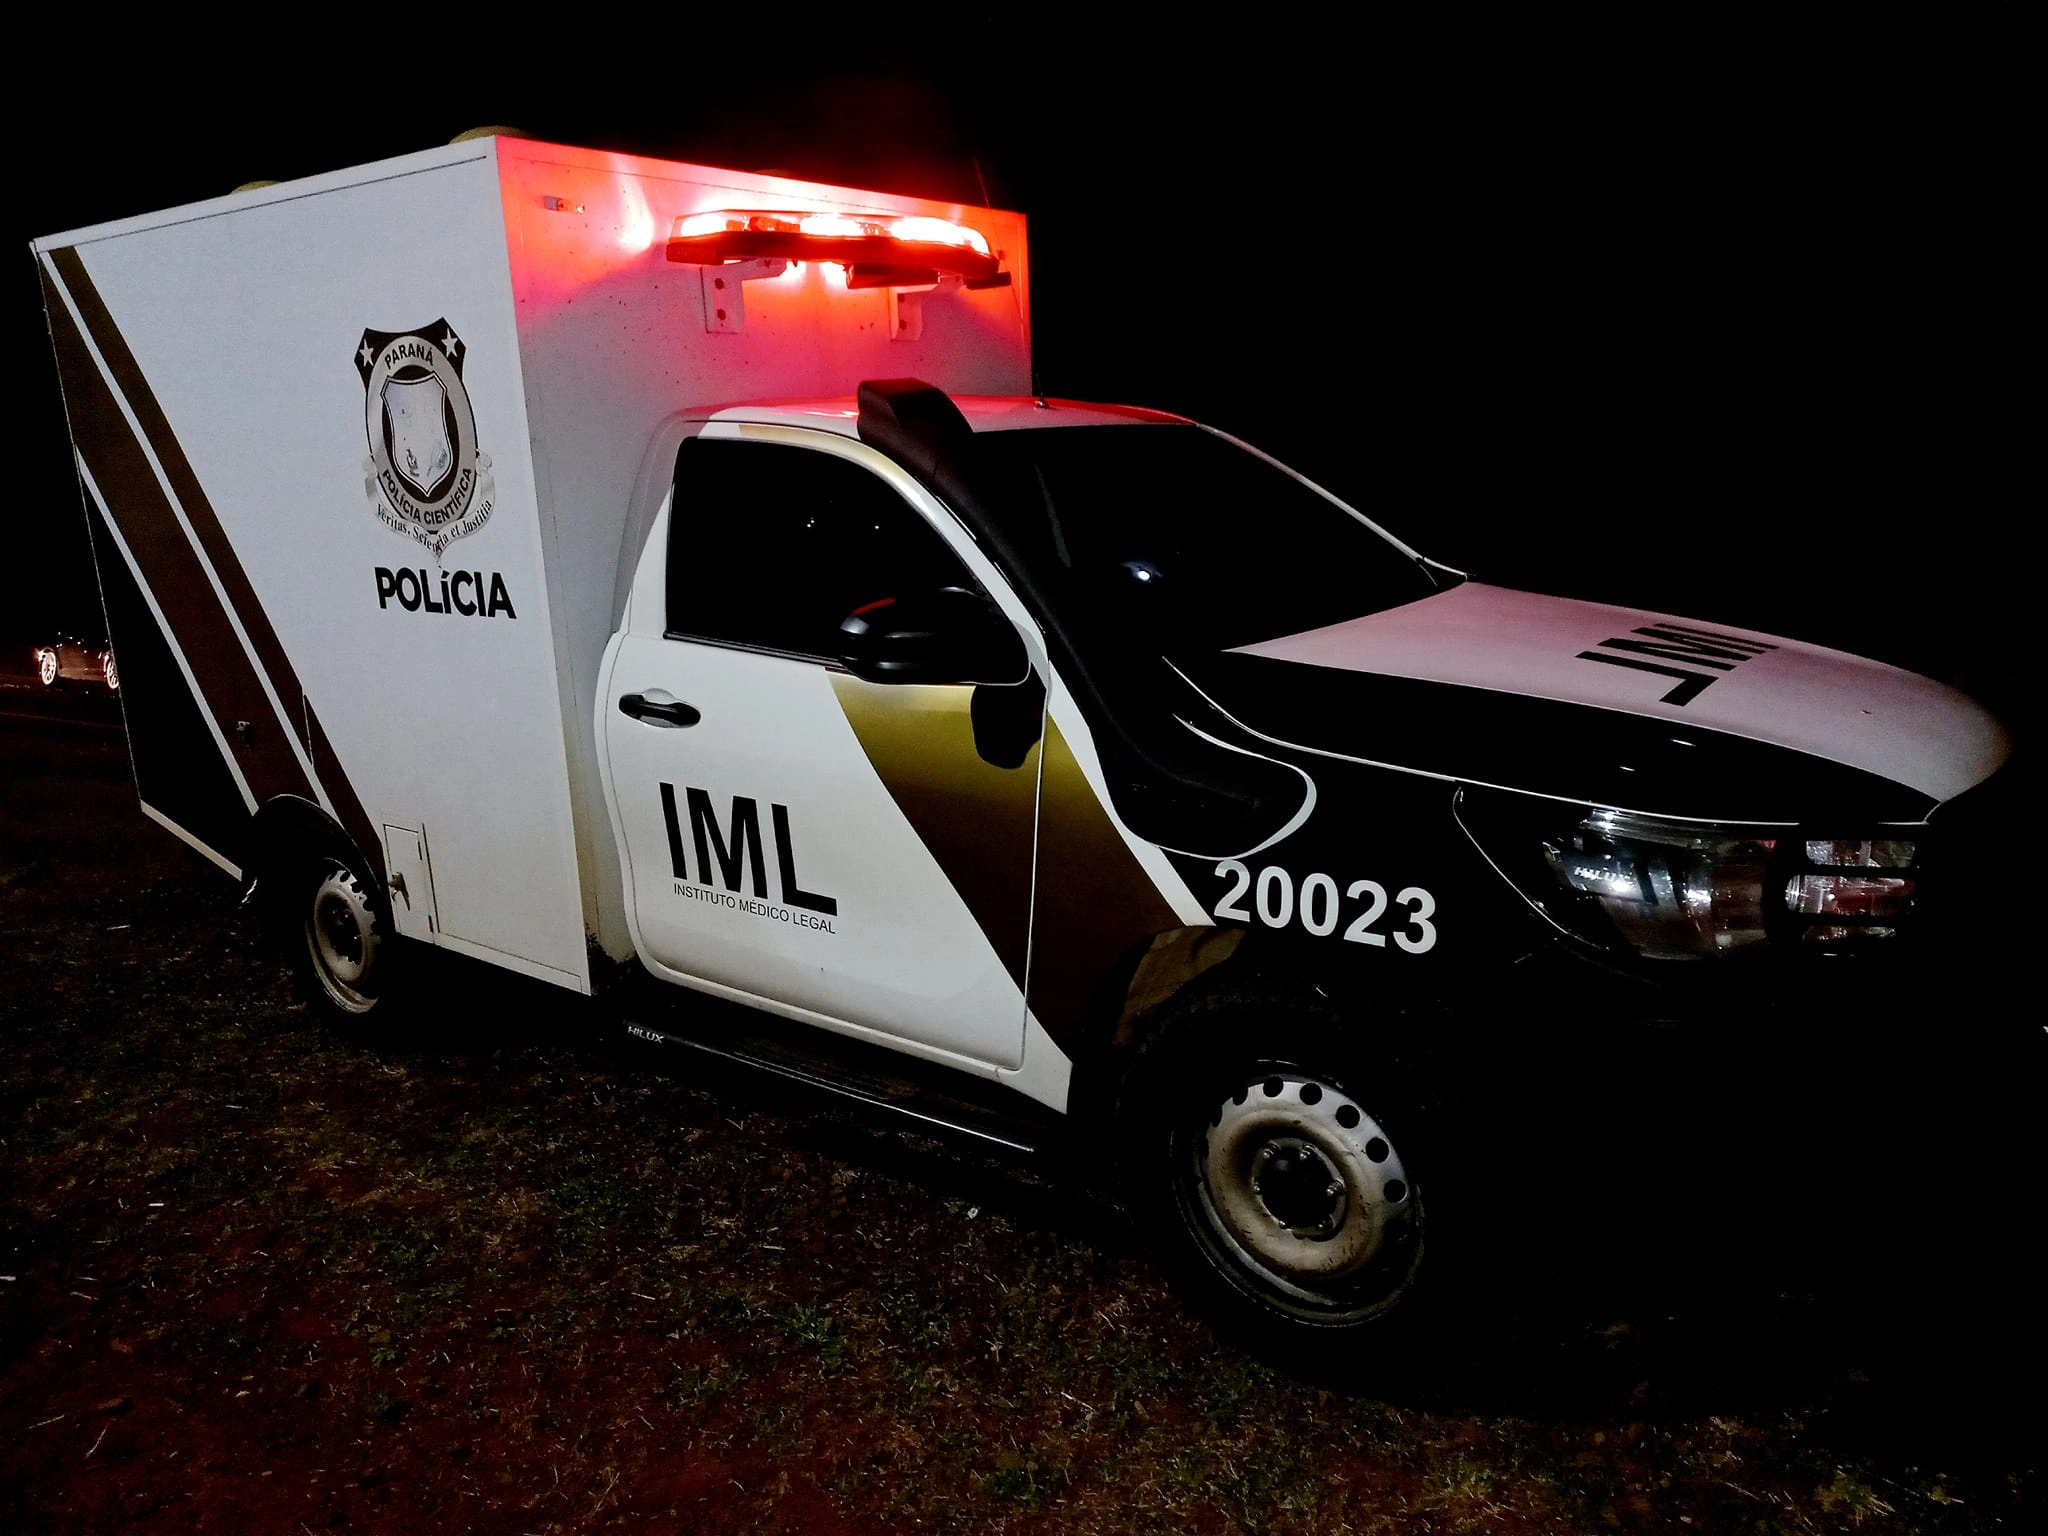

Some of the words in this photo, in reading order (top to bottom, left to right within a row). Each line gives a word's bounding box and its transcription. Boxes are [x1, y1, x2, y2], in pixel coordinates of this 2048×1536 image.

[384, 343, 434, 370] PARANÁ
[382, 469, 421, 523] POLÍCIA
[423, 468, 472, 525] CIENTÍFICA
[659, 781, 837, 916] IML
[673, 882, 736, 909] INSTITUTO
[739, 899, 790, 923] MÉDICO
[792, 911, 836, 935] LEGAL
[1213, 859, 1438, 955] 20023
[627, 1025, 665, 1044] HILUX
